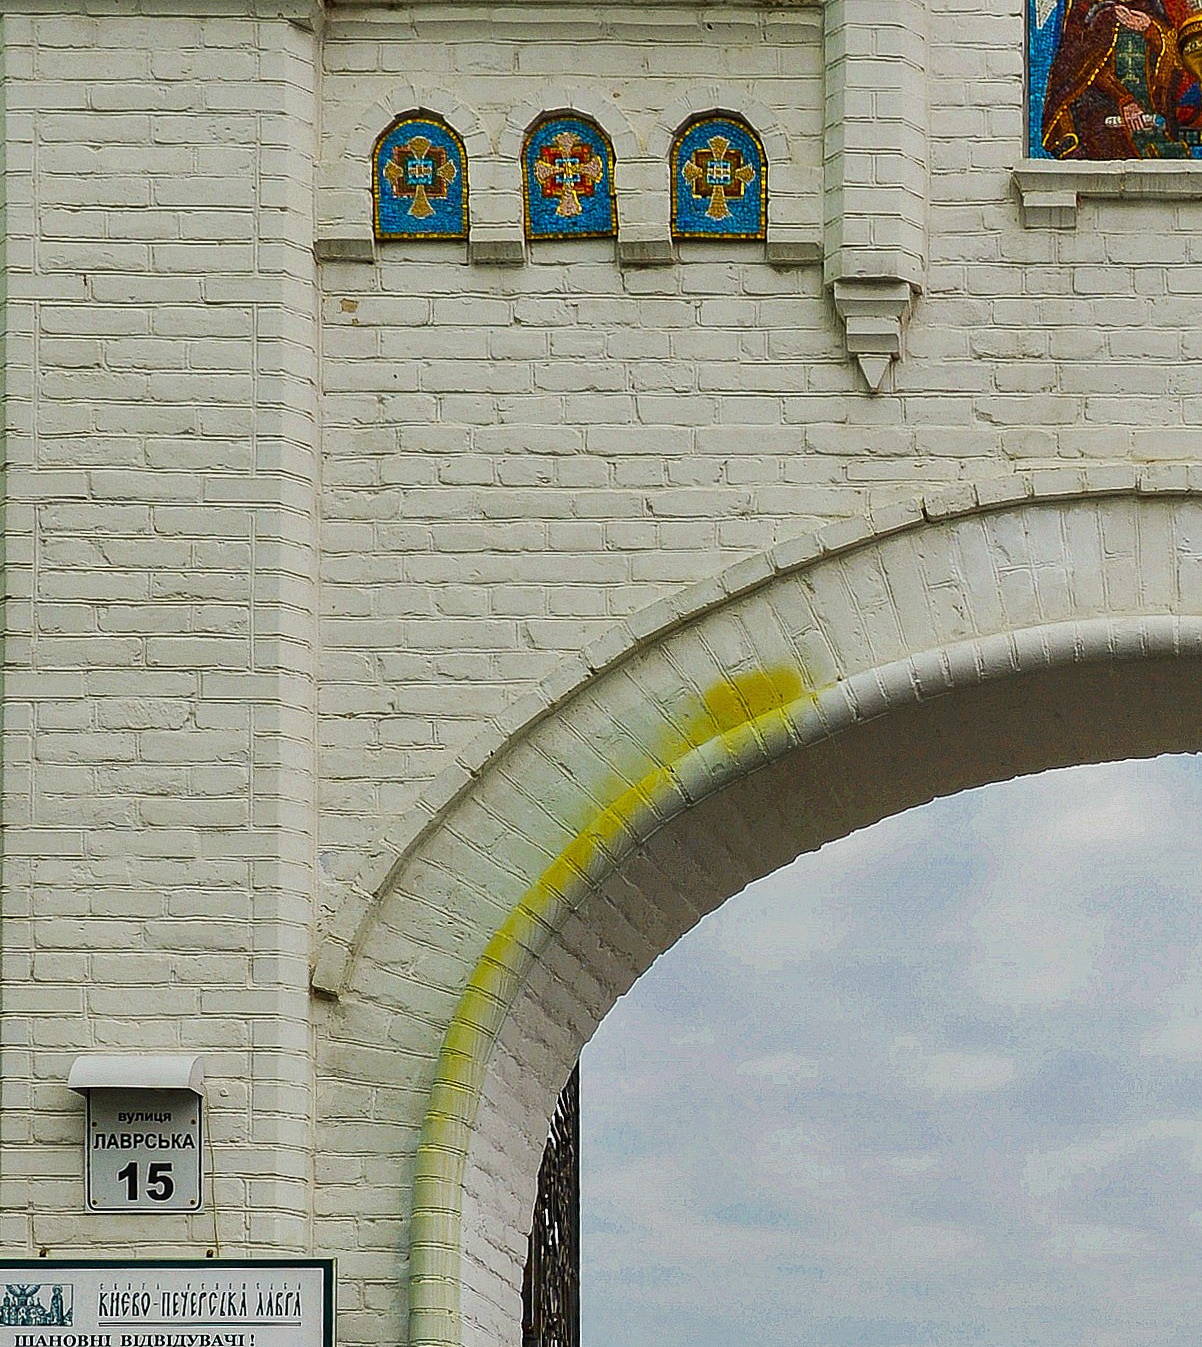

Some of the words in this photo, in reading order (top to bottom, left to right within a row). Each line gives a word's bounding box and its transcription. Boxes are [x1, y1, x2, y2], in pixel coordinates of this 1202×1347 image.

[118, 1111, 171, 1124] вулиця
[93, 1134, 195, 1150] ЛАВРСЬКА
[117, 1161, 175, 1202] 15
[14, 1334, 111, 1347] ШАНОВНІ
